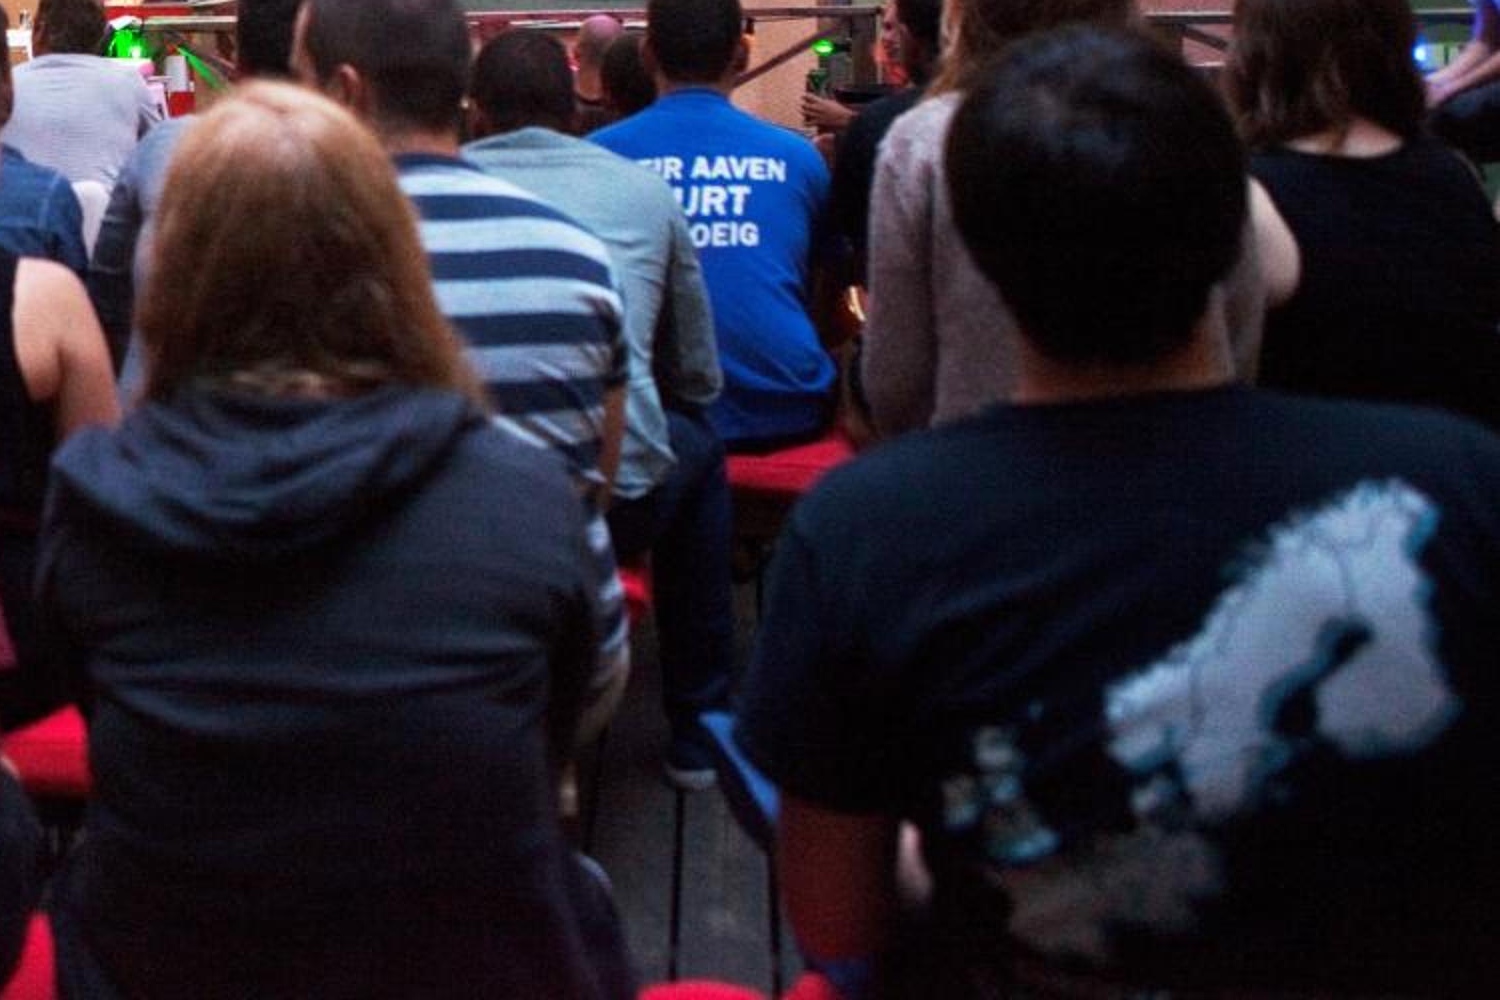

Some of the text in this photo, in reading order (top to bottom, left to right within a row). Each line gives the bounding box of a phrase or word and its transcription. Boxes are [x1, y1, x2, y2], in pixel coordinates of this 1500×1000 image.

[638, 156, 786, 181] IR AAVEN
[673, 185, 751, 215] URT
